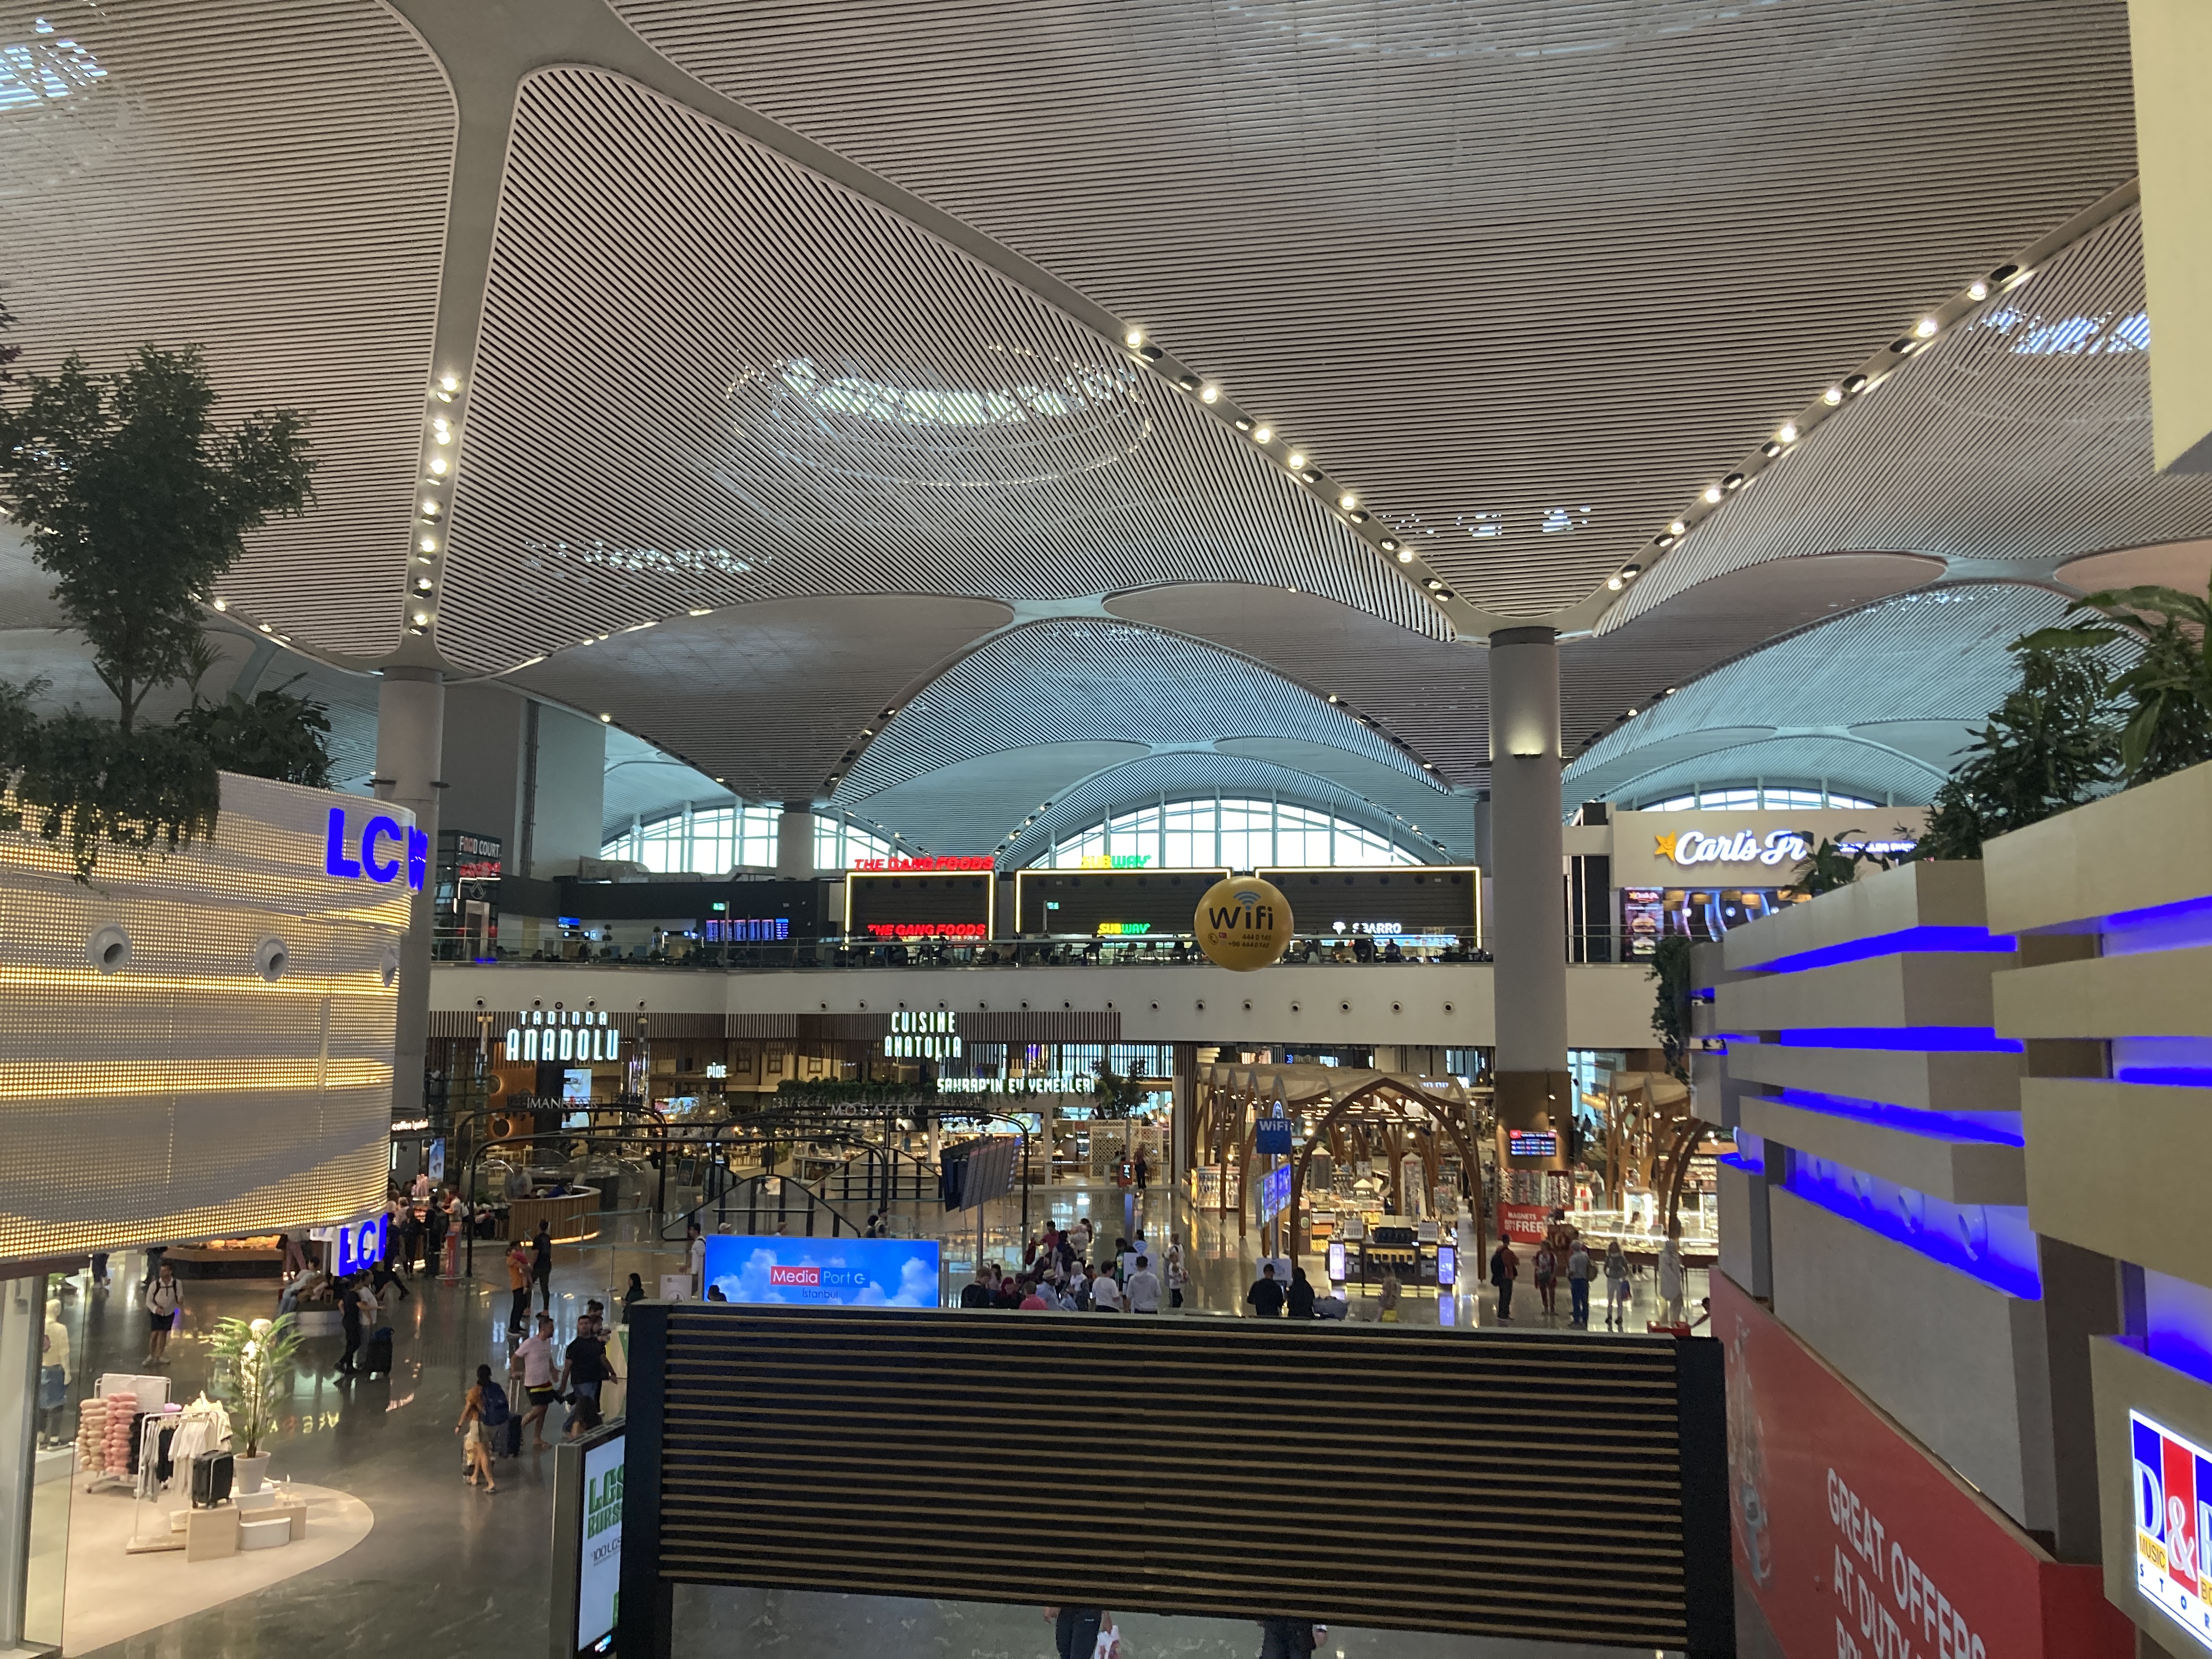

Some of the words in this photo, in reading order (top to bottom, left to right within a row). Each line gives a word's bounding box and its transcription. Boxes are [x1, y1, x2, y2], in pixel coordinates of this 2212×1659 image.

[460, 836, 478, 854] FOOD
[479, 840, 500, 858] COURT
[1675, 829, 1762, 865] Carl's
[854, 858, 884, 871] THE
[888, 857, 934, 871] GANG
[936, 856, 995, 870] FOODS
[1082, 855, 1152, 869] SUBWAY
[1209, 905, 1273, 930] Wifi
[867, 924, 894, 935] THE
[895, 924, 934, 935] GANG
[936, 924, 986, 935] FOODS
[1097, 923, 1150, 934] SUBWAY
[1352, 922, 1402, 934] SBARRO
[520, 1011, 608, 1025] TADINDA
[891, 1011, 956, 1033] CUISINE
[506, 1028, 619, 1061] ANADOLU
[884, 1035, 962, 1060] ANATOLIA
[707, 1062, 727, 1078] PİDE
[830, 1104, 917, 1116] MOSAFER
[1259, 1120, 1288, 1131] WiFi
[1508, 1211, 1537, 1221] MAGNETS
[1515, 1220, 1544, 1233] FREE
[772, 1269, 818, 1284] Media
[823, 1271, 851, 1284] Port
[588, 1500, 623, 1541] BURS
[1827, 1467, 1885, 1583] GREAT
[2140, 1535, 2166, 1569] MUSIC
[1835, 1543, 1854, 1616] AT
